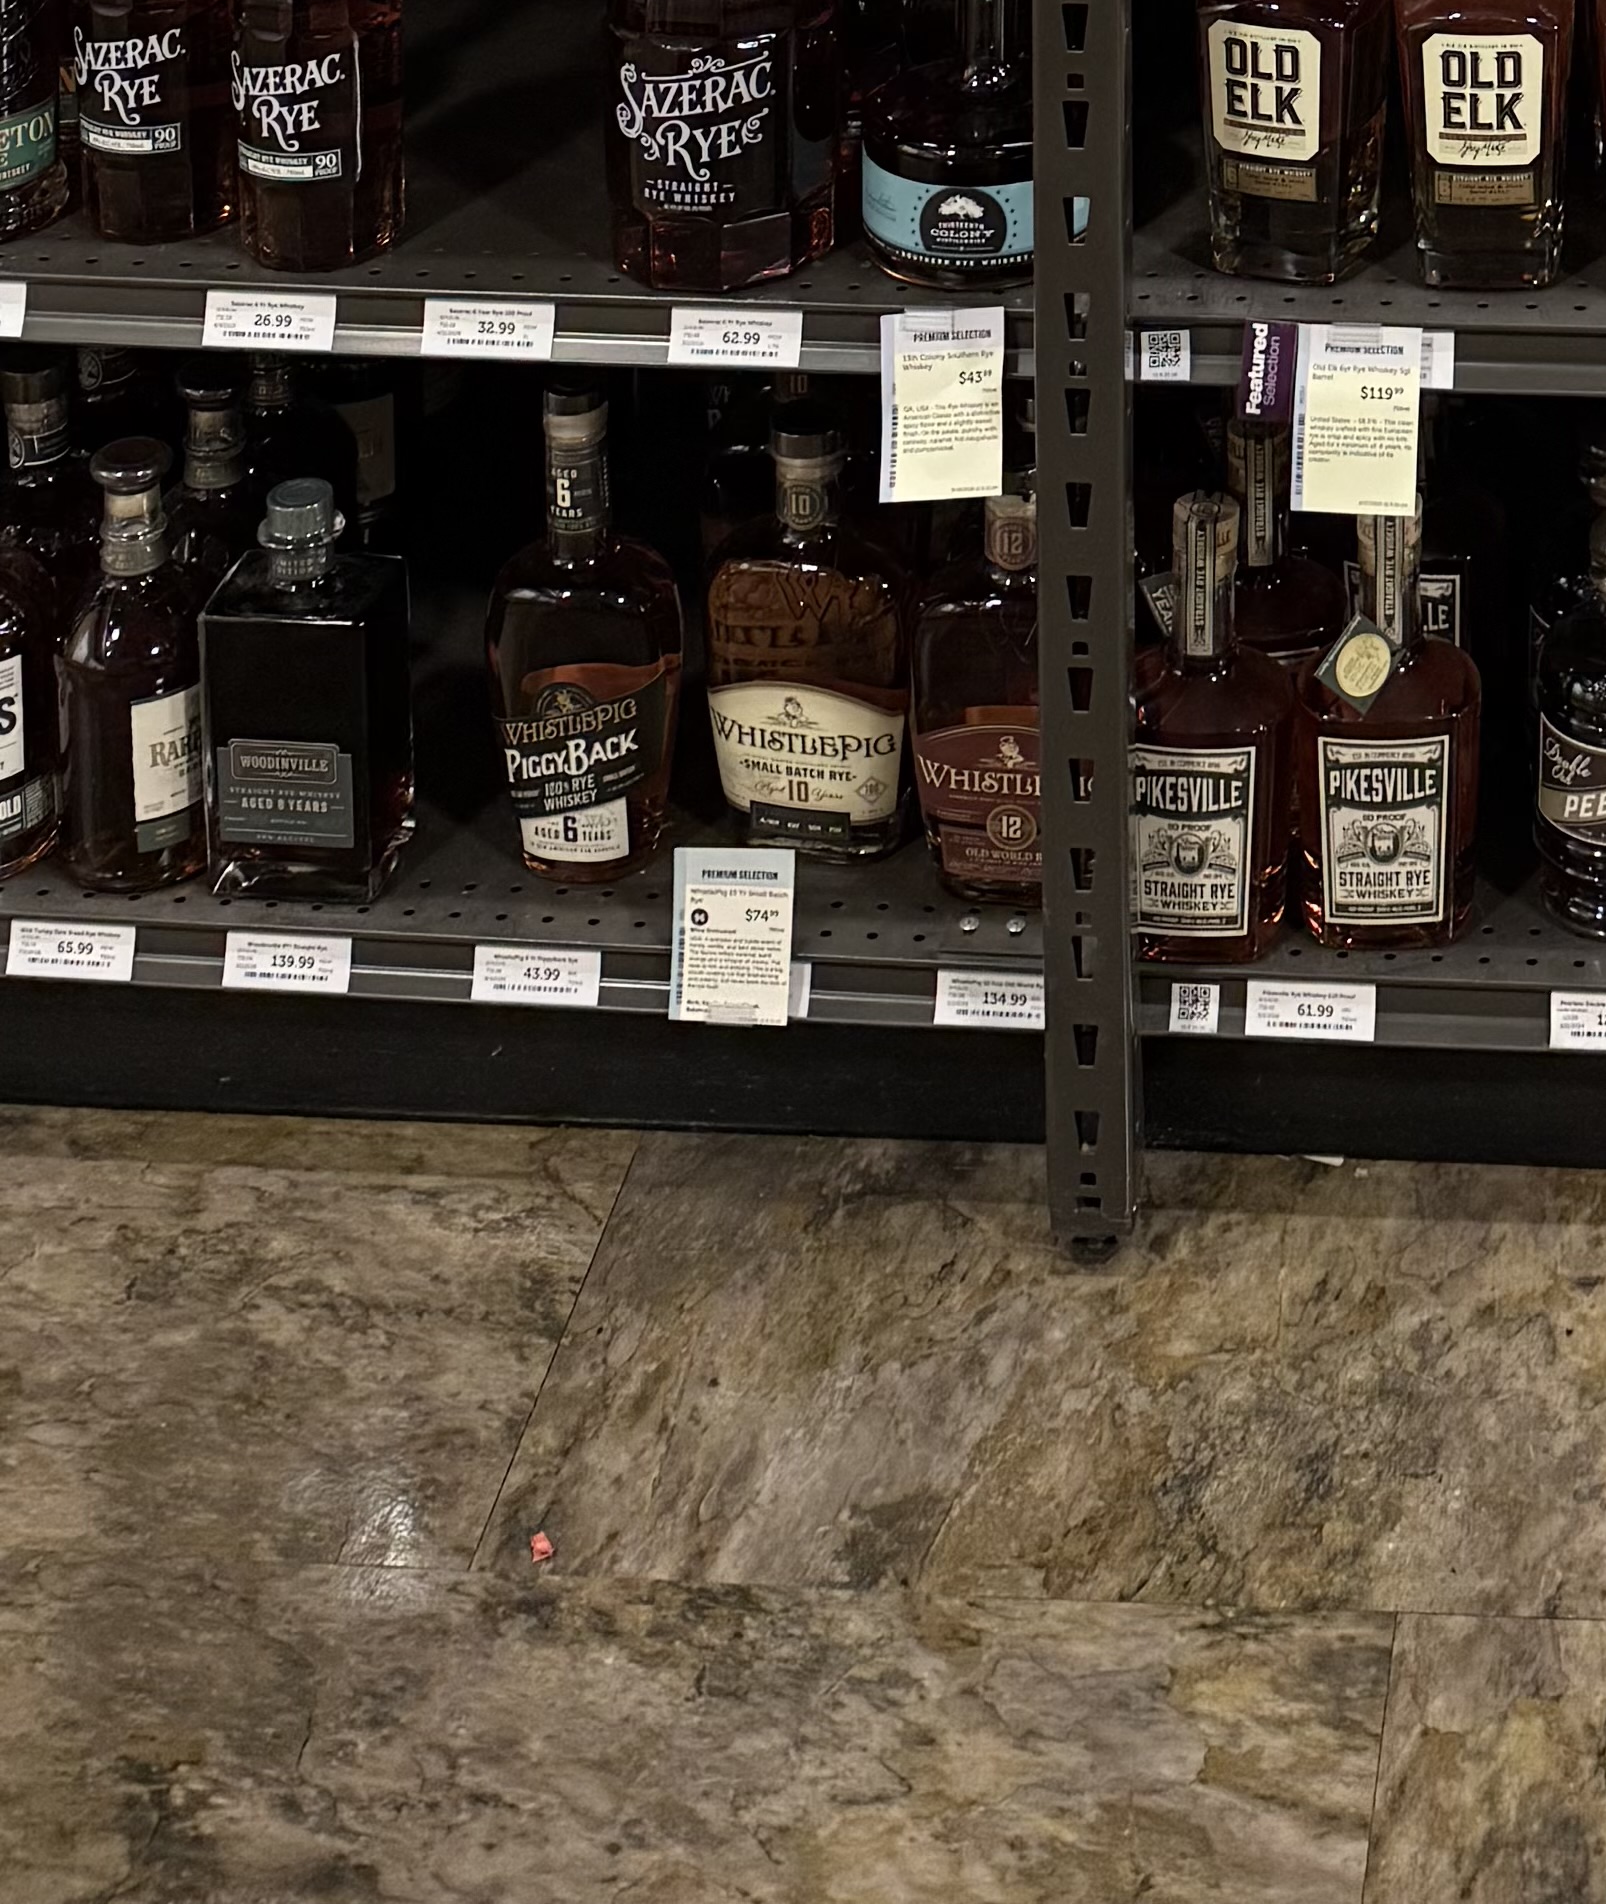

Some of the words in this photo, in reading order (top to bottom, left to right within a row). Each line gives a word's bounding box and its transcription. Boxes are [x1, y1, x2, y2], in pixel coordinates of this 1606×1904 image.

[1224, 37, 1301, 83] OLD
[1224, 78, 1303, 125] ELK
[655, 122, 741, 180] RYE
[254, 314, 292, 328] 26.99
[478, 321, 515, 335] 32.99
[722, 331, 761, 345] 62.99
[744, 760, 782, 776] SMALL
[785, 766, 825, 780] BATCH
[828, 770, 853, 782] RYE
[1330, 768, 1437, 803] PIKESVILLE
[57, 941, 94, 955] 65.99
[270, 954, 315, 970] 139.99
[1297, 1004, 1333, 1016] 61.99
